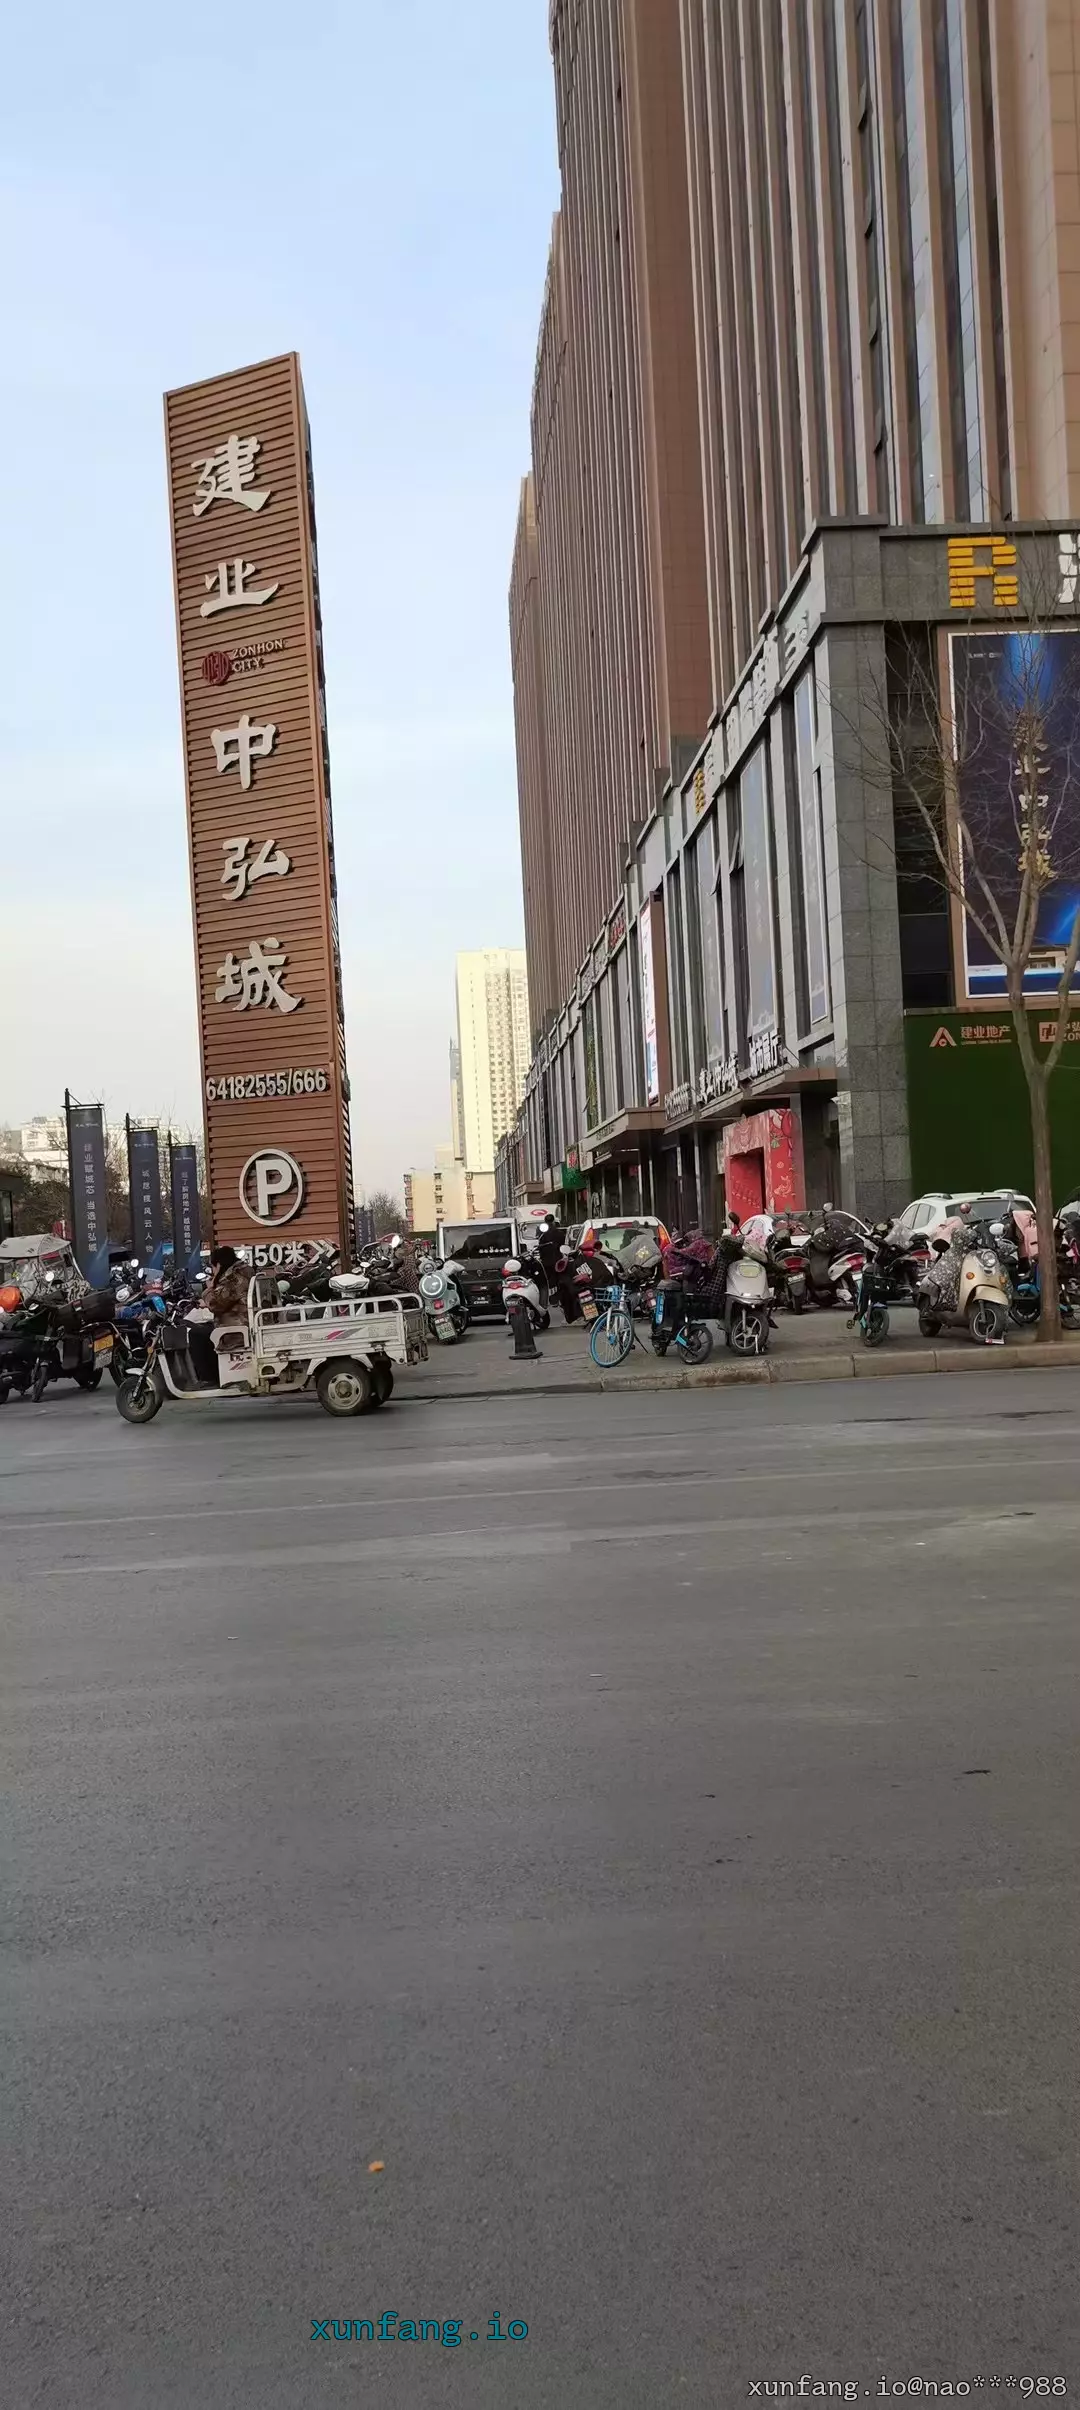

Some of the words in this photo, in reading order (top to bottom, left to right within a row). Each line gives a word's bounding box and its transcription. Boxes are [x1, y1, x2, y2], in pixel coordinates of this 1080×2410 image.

[191, 434, 280, 619] 建业
[231, 639, 284, 659] ZONHON
[231, 656, 262, 673] CITY
[211, 714, 302, 1014] 中弘城
[960, 1024, 1011, 1039] 建业地产
[206, 1067, 327, 1101] 64182555/666
[255, 1159, 293, 1217] P
